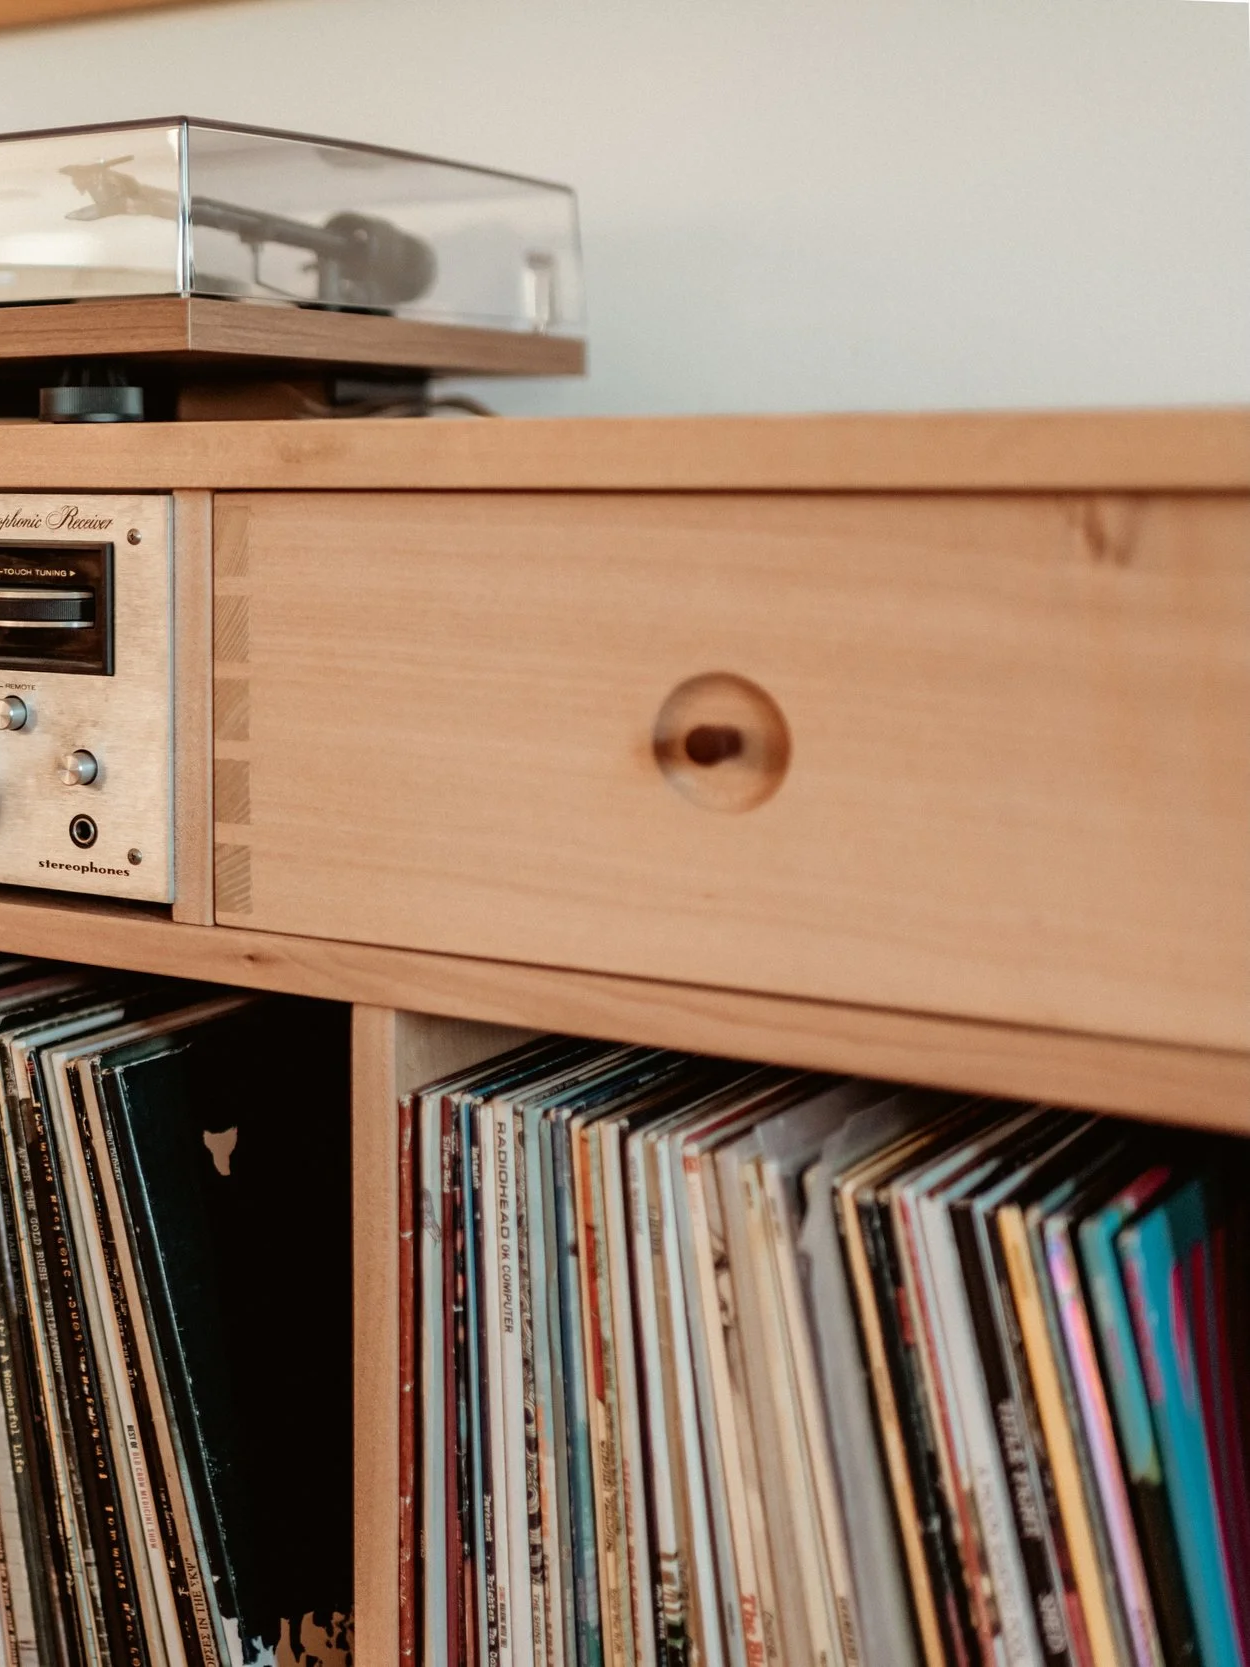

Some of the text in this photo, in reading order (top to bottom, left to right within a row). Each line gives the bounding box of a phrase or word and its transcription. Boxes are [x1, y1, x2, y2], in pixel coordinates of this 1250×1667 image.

[46, 505, 114, 530] Receiver
[35, 569, 67, 577] TUNING
[38, 858, 131, 878] stereophones
[24, 1187, 37, 1211] THE
[28, 1215, 43, 1246] GOLD
[497, 1121, 514, 1334] RADIOHEAD OK COMPUTER
[34, 1249, 49, 1281] RUSH
[0, 1354, 9, 1363] A
[3, 1369, 20, 1435] Wonderful
[13, 1440, 25, 1474] Life
[145, 1526, 158, 1550] SHOW
[192, 1590, 204, 1614] THE
[534, 1615, 542, 1645] SHINS
